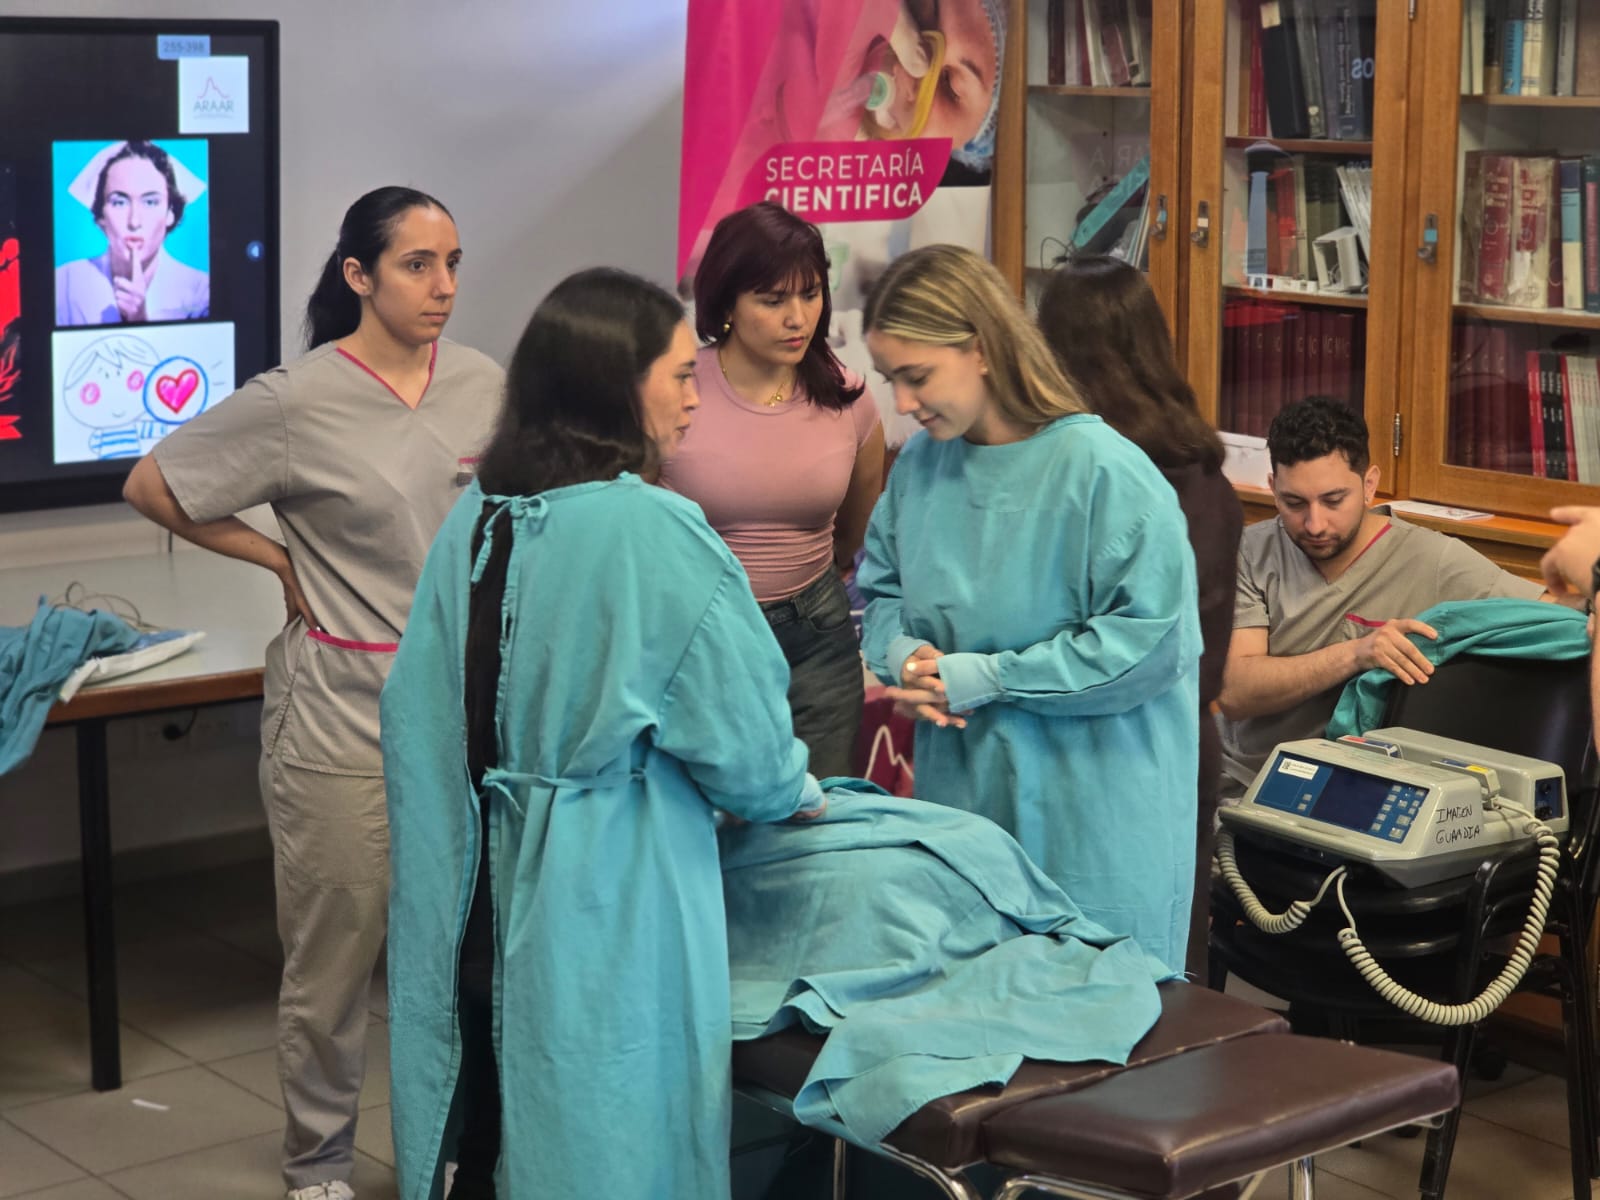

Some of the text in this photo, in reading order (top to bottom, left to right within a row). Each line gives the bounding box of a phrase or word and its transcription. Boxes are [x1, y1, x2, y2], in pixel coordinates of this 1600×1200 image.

[193, 100, 235, 112] ARAAR
[766, 147, 925, 182] SECRETARÍA
[1435, 825, 1480, 844] GUARDIA
